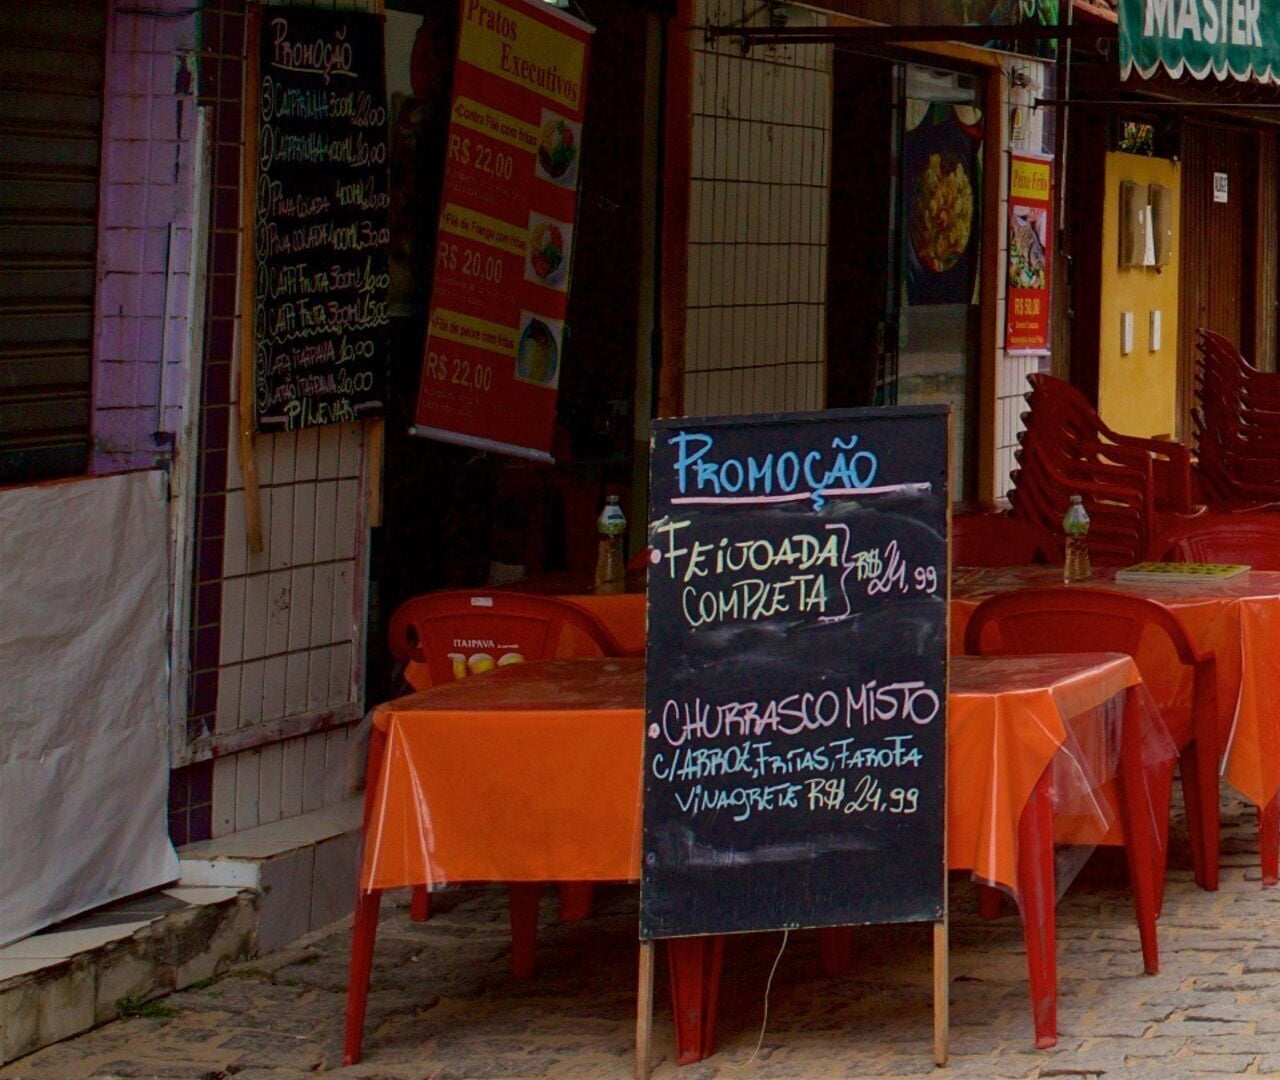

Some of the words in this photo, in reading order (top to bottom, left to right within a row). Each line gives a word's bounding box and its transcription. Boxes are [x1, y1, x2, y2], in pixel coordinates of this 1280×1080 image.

[271, 17, 353, 86] PROMOÇÃO
[501, 41, 579, 103] Executivos
[448, 134, 471, 167] R$
[474, 144, 514, 181] 22,00
[440, 240, 459, 271] R$
[461, 248, 504, 284] 20,00
[425, 351, 448, 381] R$
[451, 358, 493, 392] 22,00
[669, 432, 878, 512] PROMOÇÃO
[660, 520, 842, 584] FEIJOADA
[857, 549, 883, 584] R$
[682, 573, 828, 628] COMPLETA
[452, 638, 495, 649] ITAIPAVA
[662, 688, 842, 748] CHURRASCO
[845, 679, 942, 732] MISTO
[832, 733, 924, 769] FAROFA
[674, 782, 803, 822] VINAGRETE
[805, 777, 844, 813] R$
[843, 774, 920, 816] 24,99
